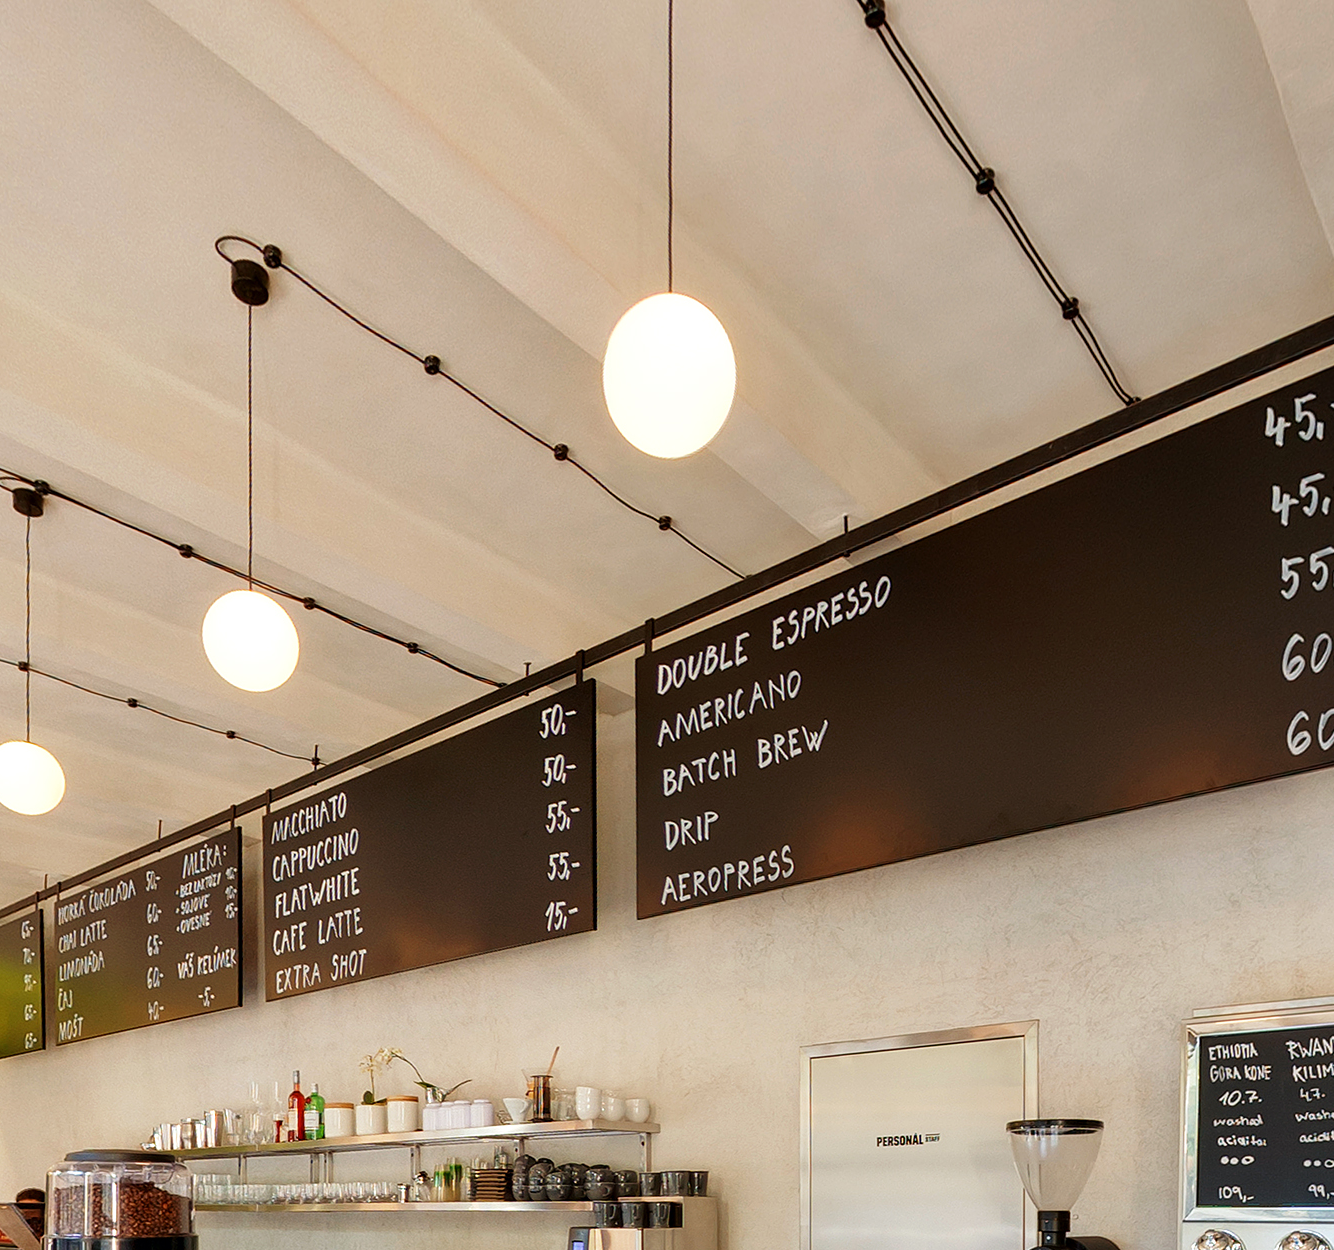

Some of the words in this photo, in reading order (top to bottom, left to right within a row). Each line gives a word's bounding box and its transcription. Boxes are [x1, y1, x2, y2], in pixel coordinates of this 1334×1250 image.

[656, 631, 751, 696] DOUBLE
[771, 575, 892, 651] ESPRESSO
[656, 669, 802, 748] AMERICANO
[662, 748, 738, 797] BATCH
[757, 719, 829, 769] BREW
[271, 791, 348, 845] MACCHIATO
[664, 810, 719, 851] DRIP
[272, 827, 360, 882] CAPPUCCINO
[660, 844, 796, 905] AEROPRESS
[80, 919, 107, 947] LATTE
[272, 921, 308, 957] CAFE
[318, 906, 364, 946] LATTE
[275, 961, 322, 994] EXTRA
[330, 948, 367, 982] SHOT
[876, 1132, 924, 1147] PERSONÁL
